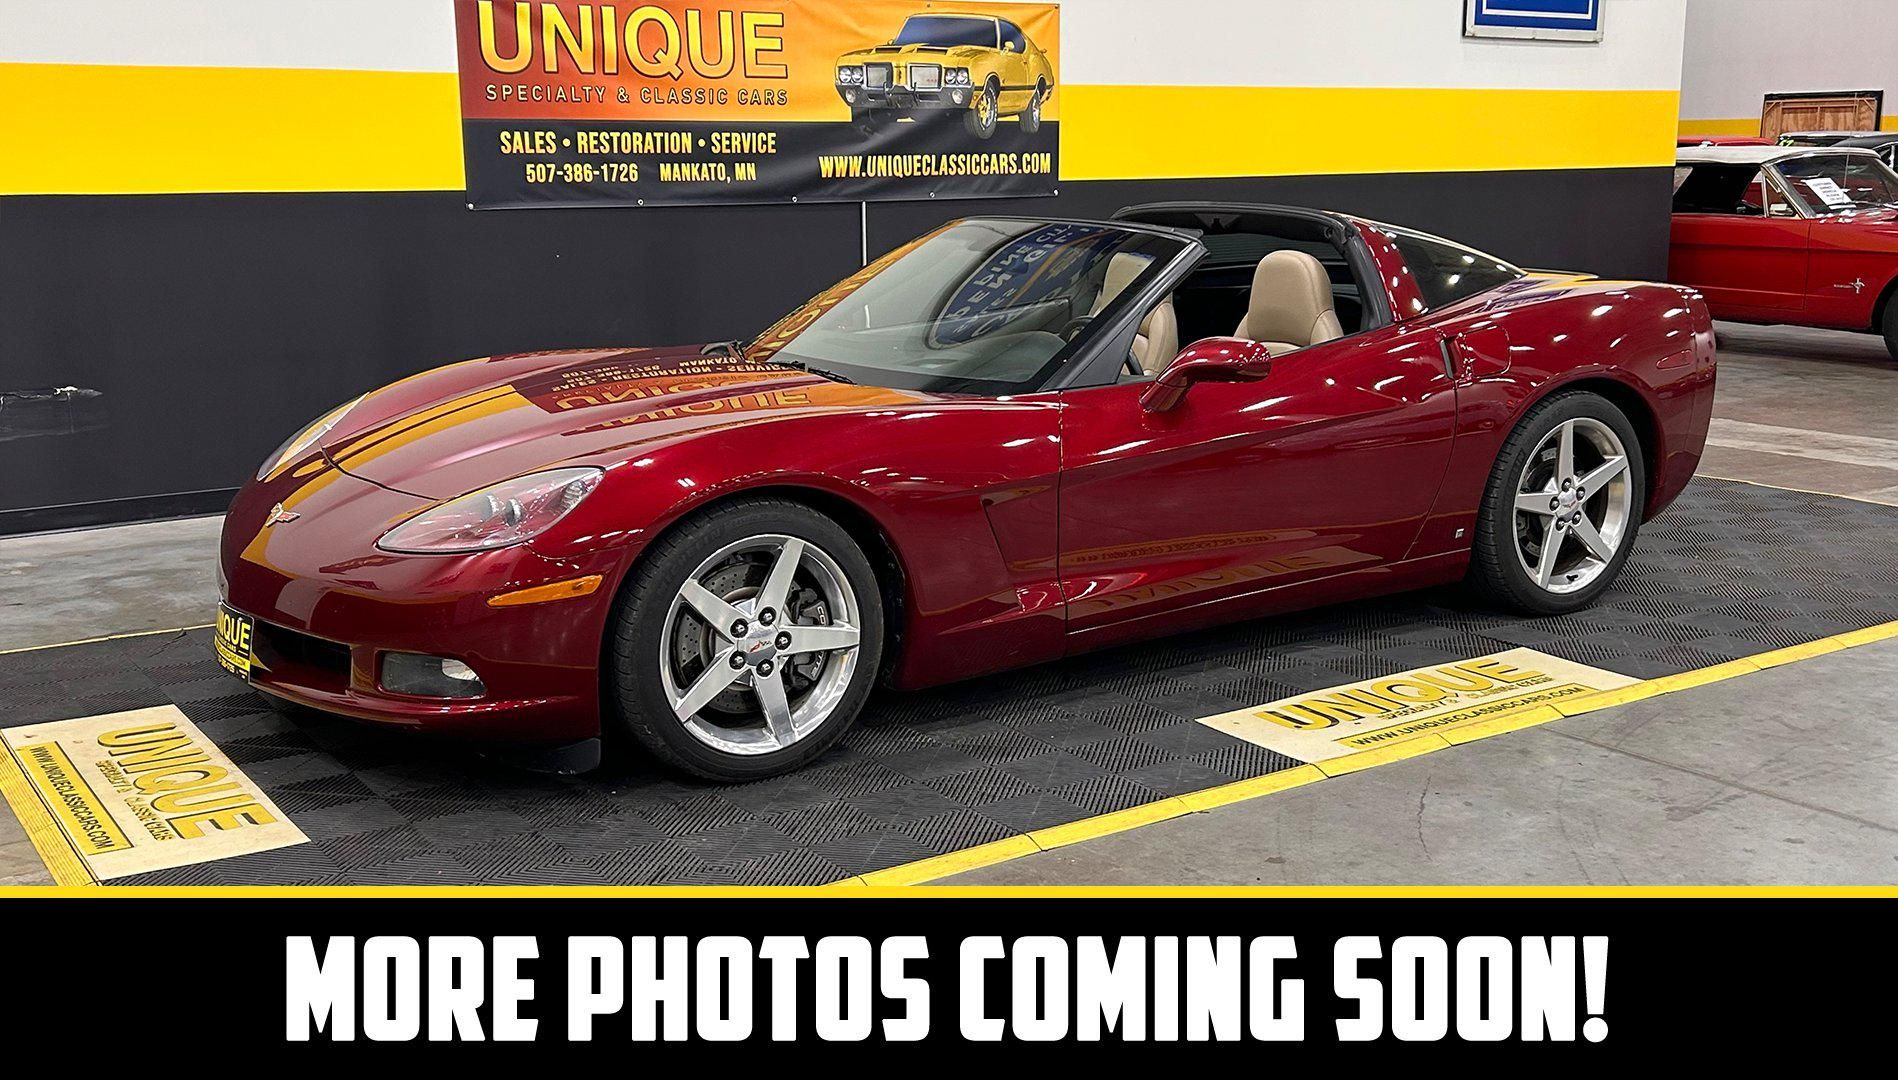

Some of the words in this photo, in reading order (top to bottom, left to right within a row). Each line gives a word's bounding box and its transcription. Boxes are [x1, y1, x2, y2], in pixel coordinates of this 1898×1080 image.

[477, 0, 788, 80] UNIQUE
[486, 84, 606, 103] SPECIALTY
[617, 86, 629, 103] &
[640, 87, 728, 104] CLASSIC
[738, 88, 788, 105] CARS
[500, 131, 556, 154] SALES
[576, 131, 692, 154] RESTORATION
[711, 132, 777, 154] SERVICE
[526, 163, 639, 183] 507-386-1726
[659, 162, 731, 184] MANKATO,
[735, 162, 757, 181] MN
[818, 152, 1051, 178] WWW.UNIQUECLASSICCARS.COM
[1257, 659, 1545, 731] UNIQUE
[1352, 685, 1585, 747] WWW.UNIQUECLASSICCARS.COM
[30, 746, 115, 850] WWW.UNIQUECLASSICCARS.COM
[97, 722, 277, 840] UNIQUE
